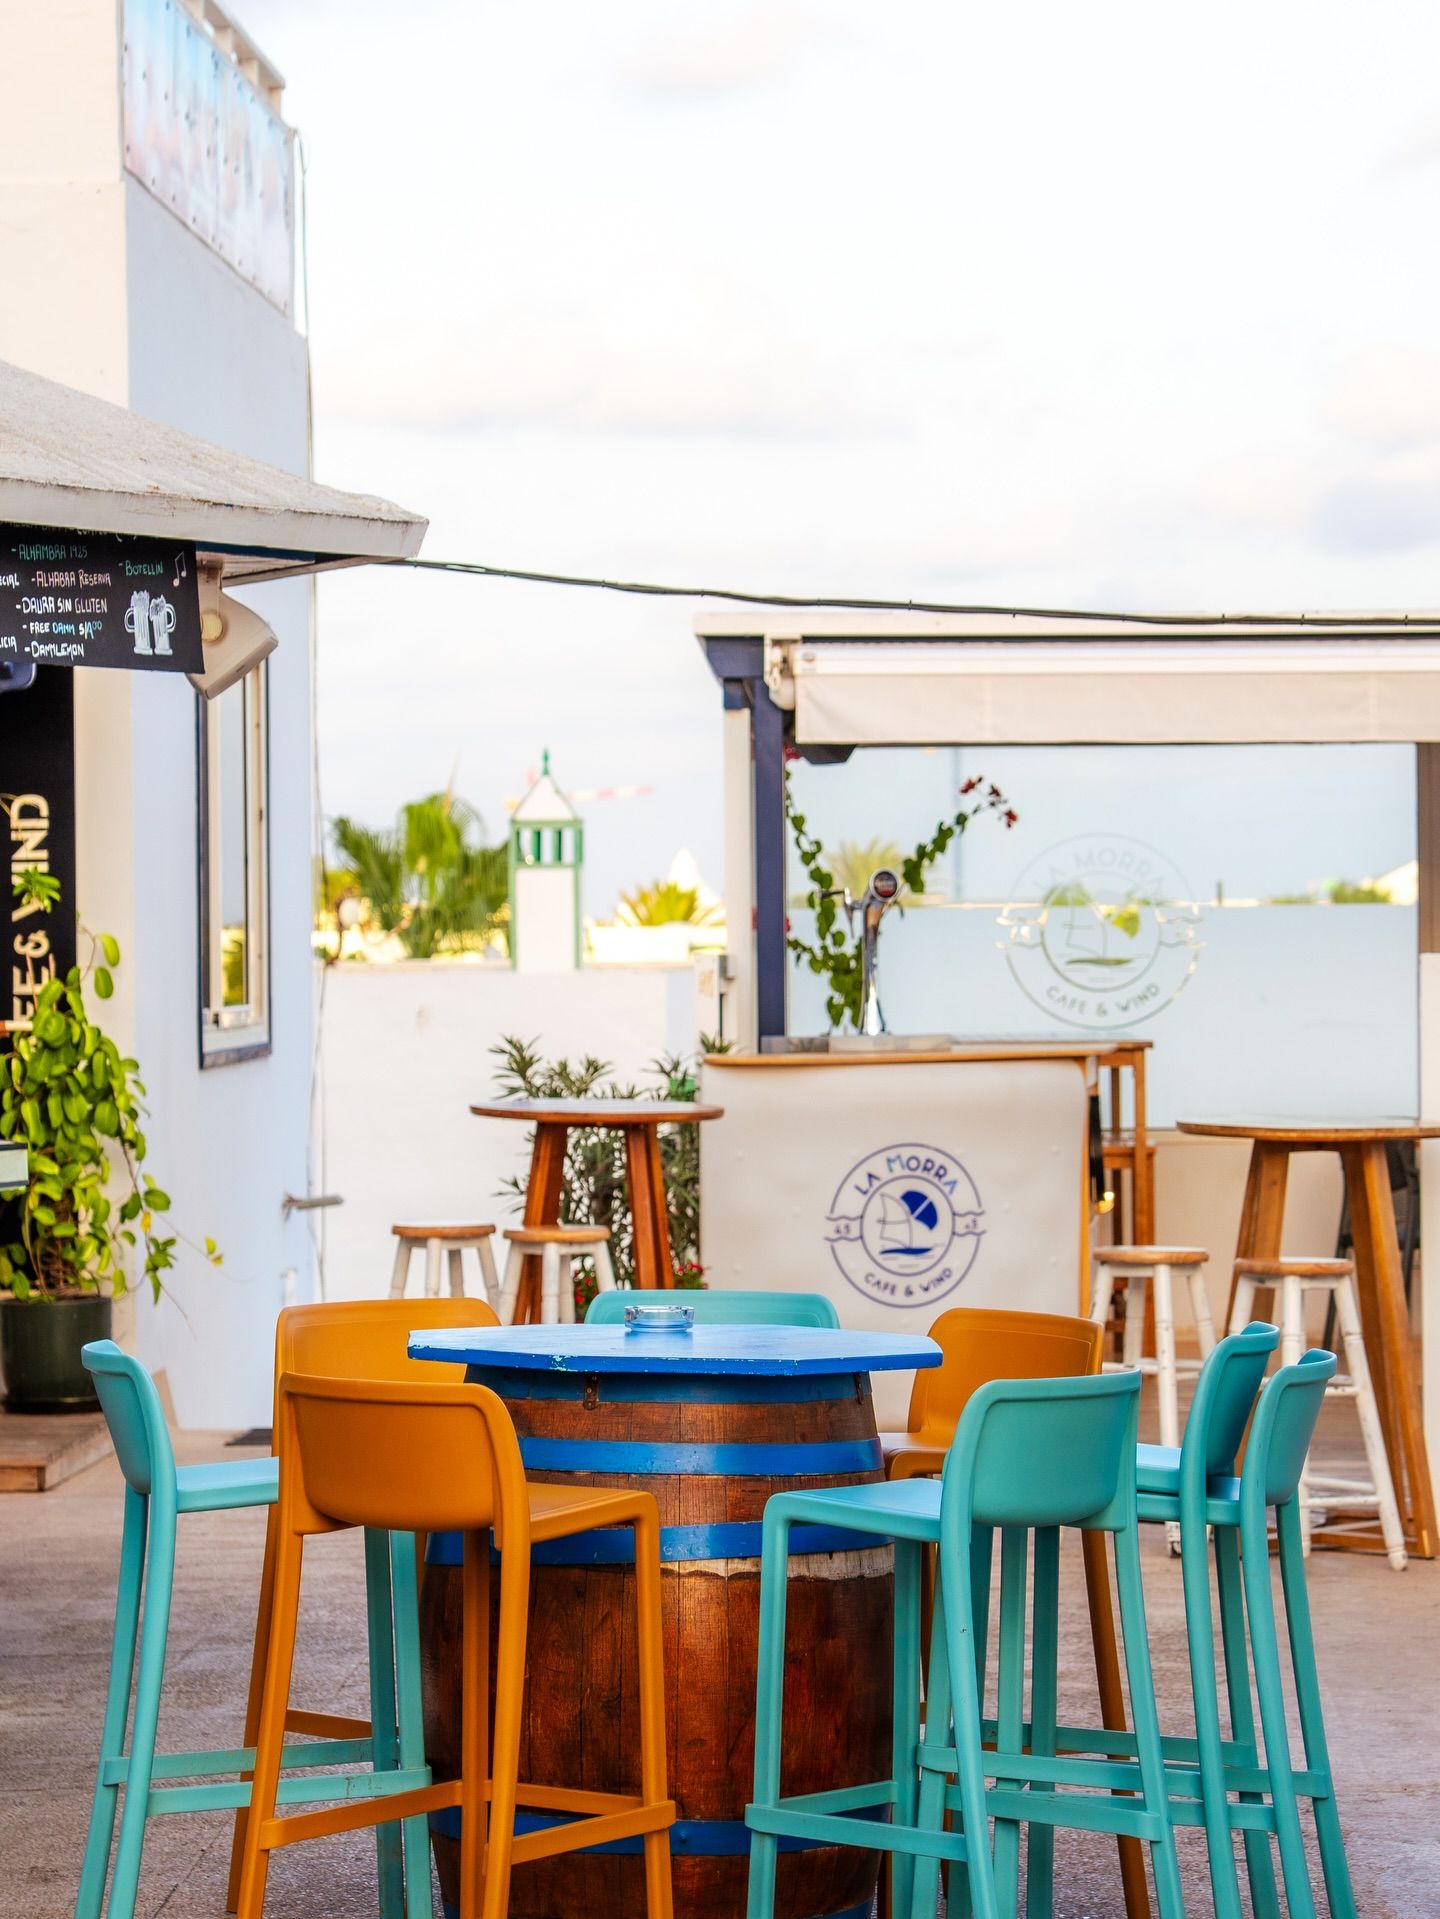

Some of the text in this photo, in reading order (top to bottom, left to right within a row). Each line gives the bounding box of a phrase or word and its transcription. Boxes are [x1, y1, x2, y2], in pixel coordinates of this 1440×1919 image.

[57, 598, 72, 613] SIN
[75, 598, 108, 614] GLUTEN
[0, 636, 17, 653] ICIA
[1115, 982, 1161, 1012] WIND
[854, 1154, 958, 1196] LA MORRA
[904, 1285, 914, 1297] &
[919, 1267, 953, 1292] WIND
